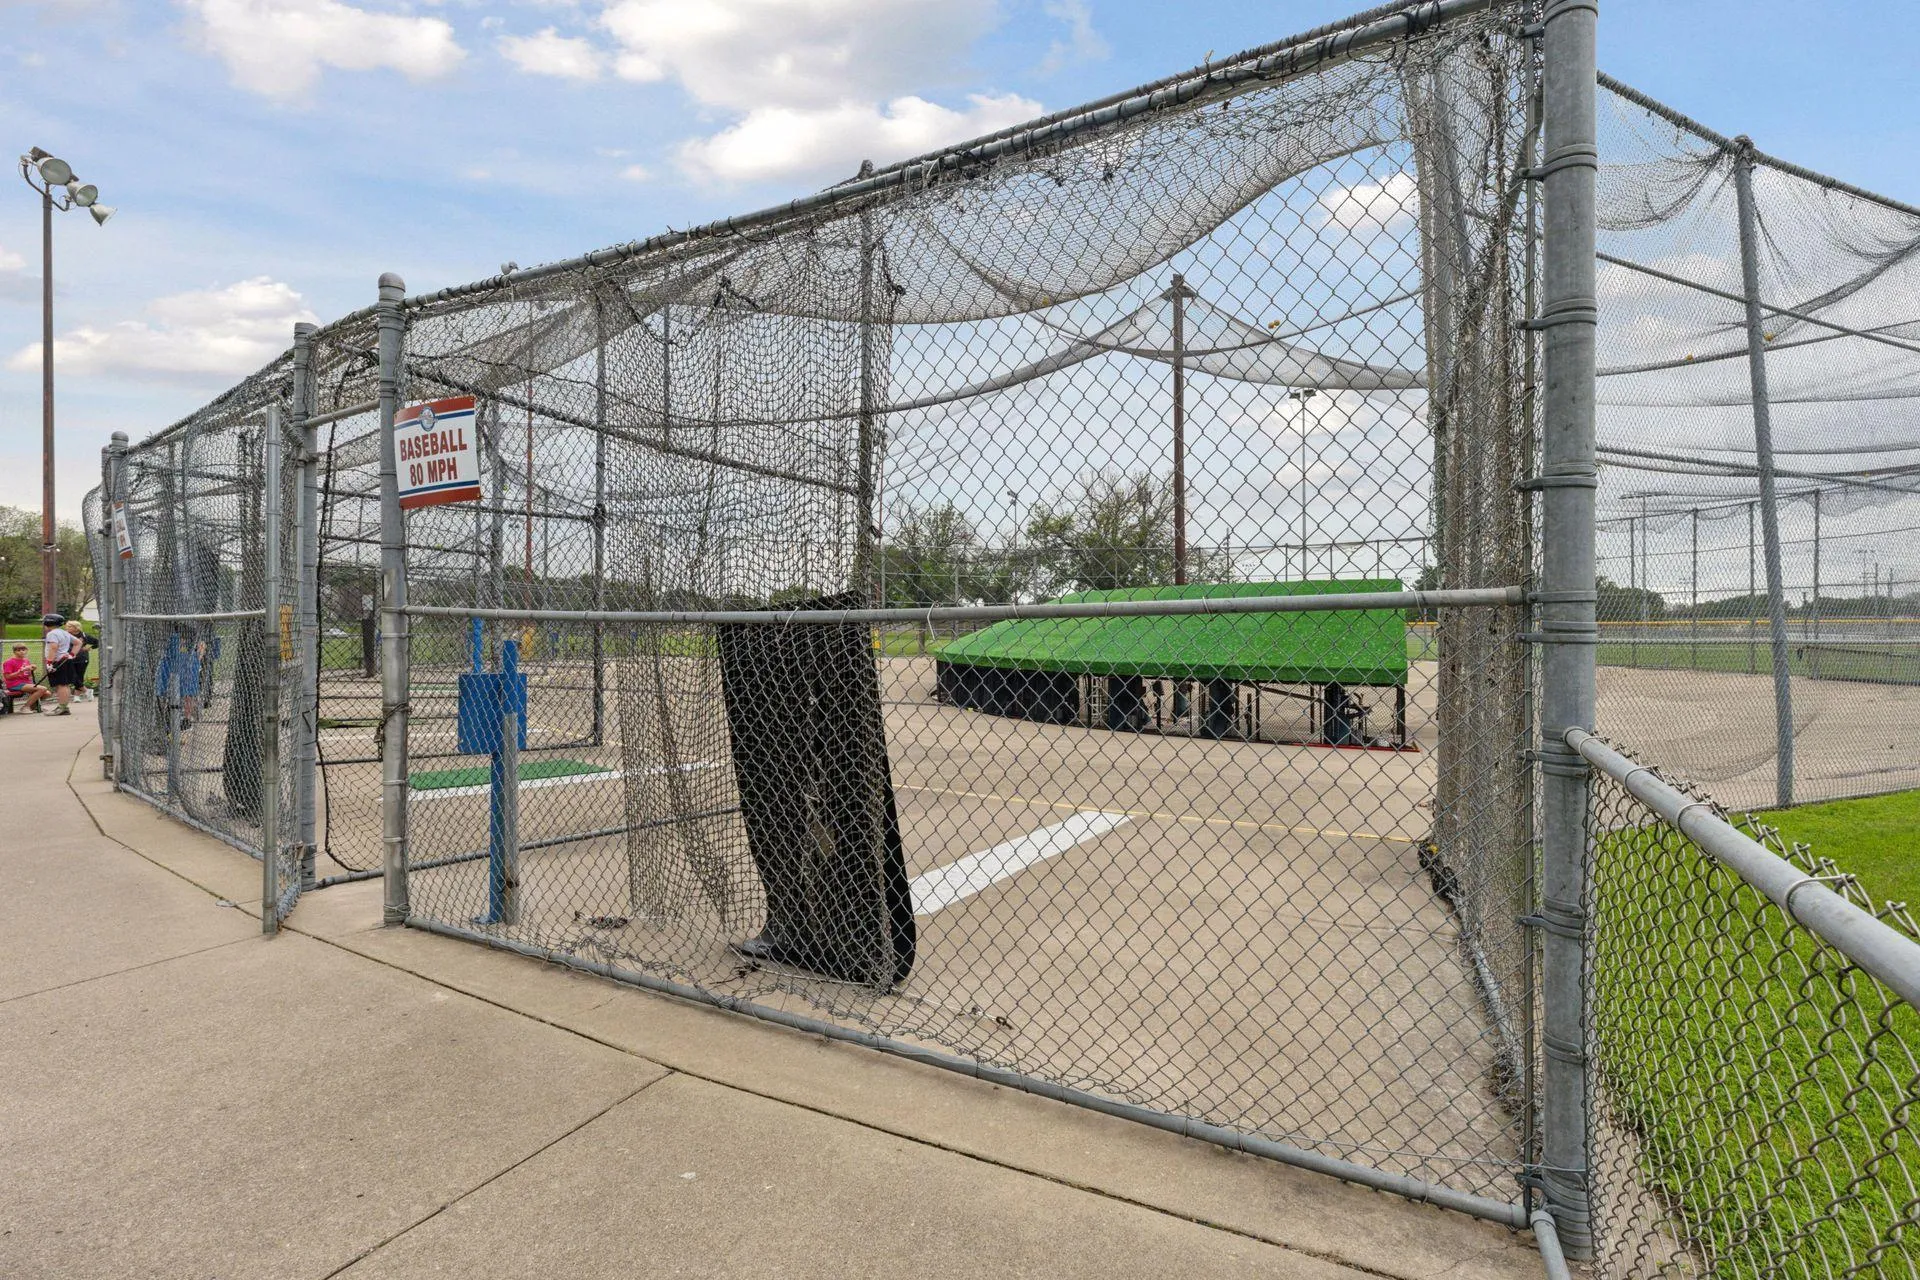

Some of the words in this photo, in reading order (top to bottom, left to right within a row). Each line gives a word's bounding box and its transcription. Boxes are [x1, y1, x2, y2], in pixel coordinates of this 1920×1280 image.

[400, 428, 467, 462] BASEBALL
[409, 462, 423, 487] 80
[427, 457, 458, 483] MPH
